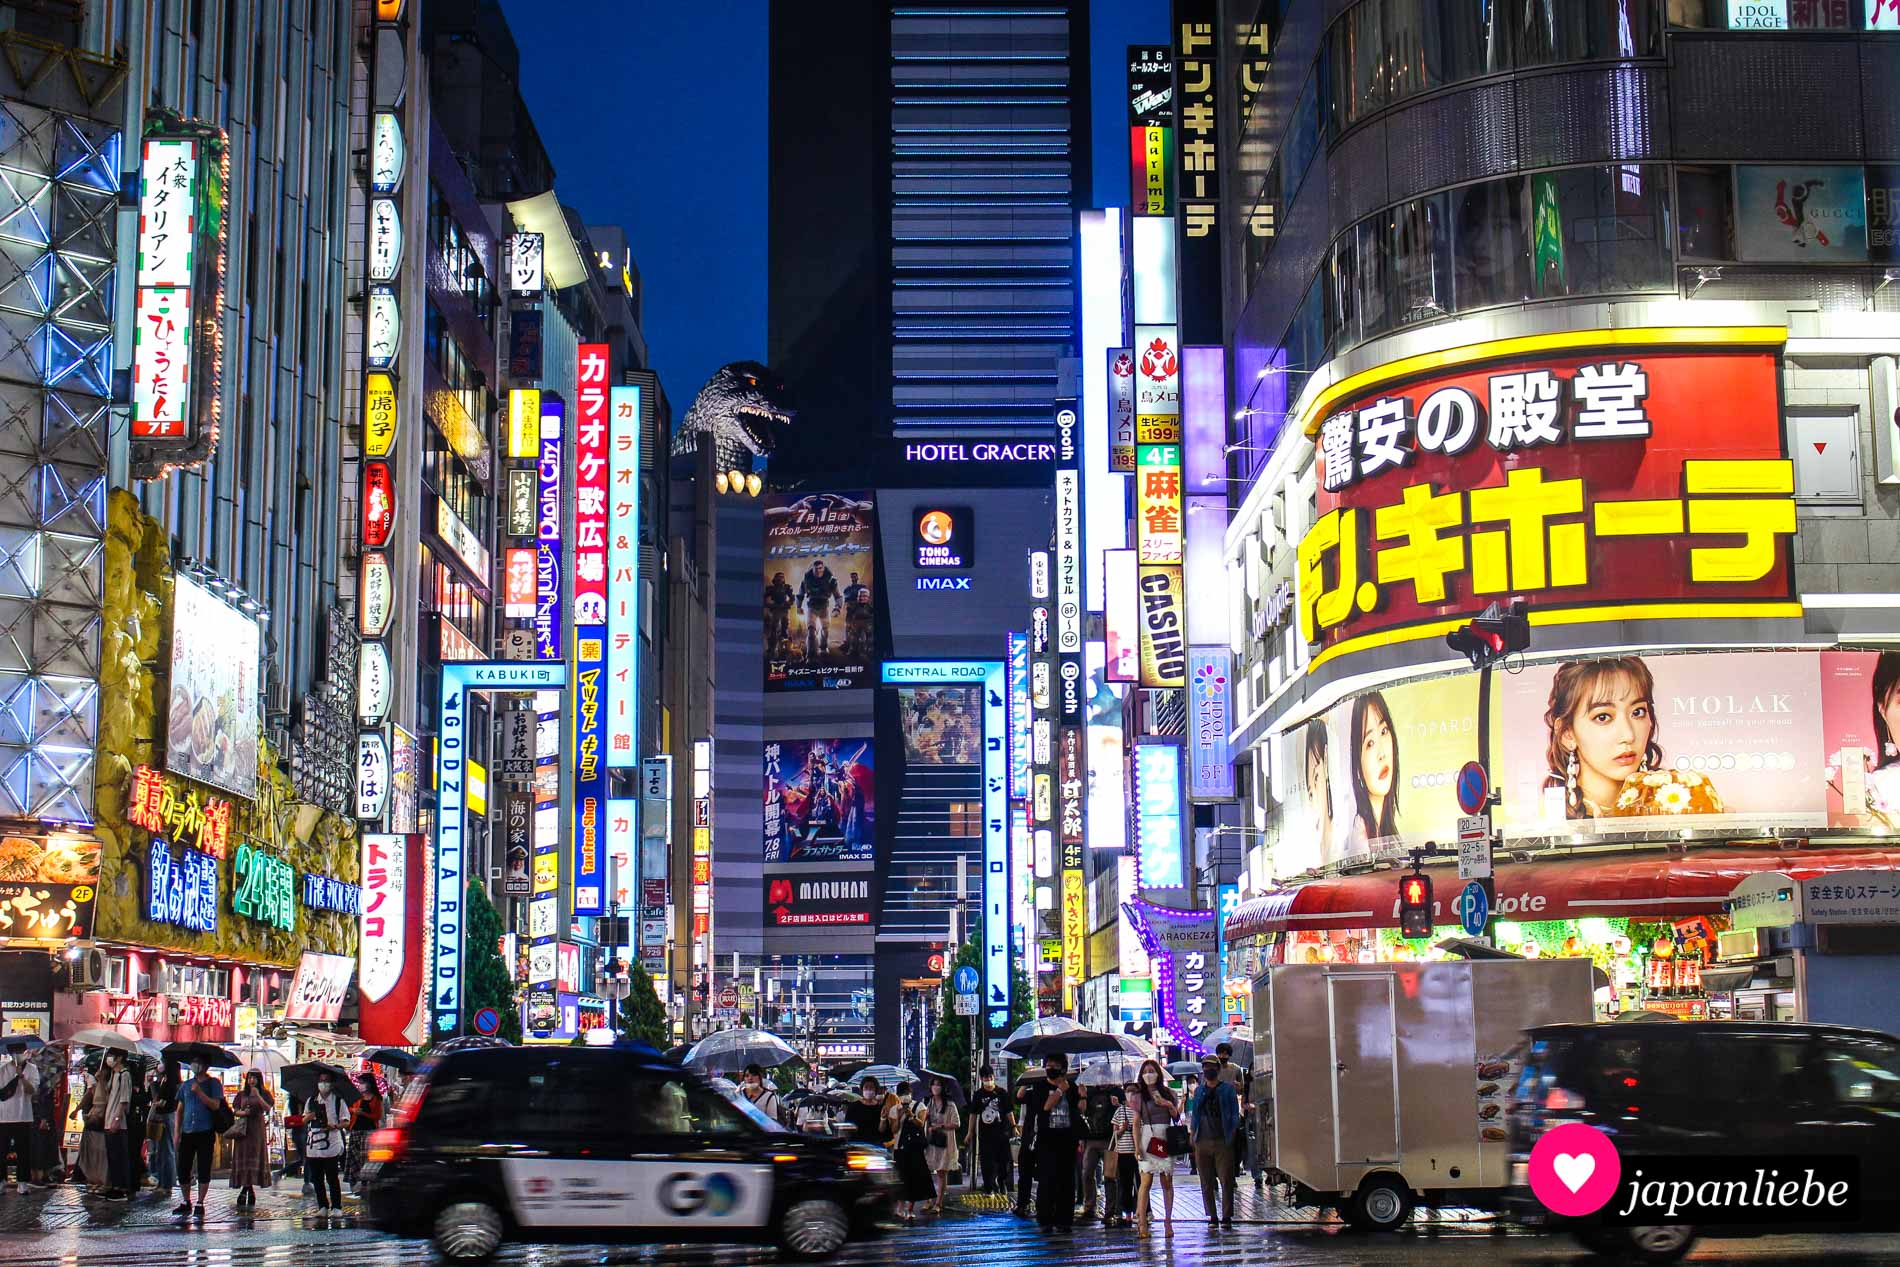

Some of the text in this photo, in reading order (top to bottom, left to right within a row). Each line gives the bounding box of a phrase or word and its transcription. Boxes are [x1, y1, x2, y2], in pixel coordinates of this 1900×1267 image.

[1735, 17, 1782, 28] STAGE
[1739, 5, 1778, 17] IDOL
[172, 156, 189, 189] 大衆
[1147, 131, 1163, 196] Garam
[377, 183, 390, 192] 7F
[150, 164, 173, 272] イタリアン
[1810, 208, 1863, 218] GUCCI
[372, 266, 392, 279] 6F
[517, 237, 536, 285] ダーツ
[147, 314, 175, 419] ひょうたん
[373, 357, 386, 366] 5F
[369, 396, 393, 437] 虎の子
[1141, 389, 1179, 404] 鳥メロ
[147, 421, 172, 435] 7F
[1057, 409, 1076, 461] Booth
[1117, 398, 1132, 442] 鳥メロ
[1141, 417, 1180, 428] 生ビール
[1321, 361, 1652, 493] 驚安の殿堂
[368, 444, 383, 453] 4F
[576, 353, 606, 582] カラオケ歌広場
[906, 444, 969, 461] HOTEL
[1145, 447, 1176, 464] 4F
[512, 472, 532, 527] 山内農場
[1062, 476, 1074, 536] ネットカフェ
[1144, 470, 1180, 534] 麻雀
[383, 512, 391, 531] 3F
[919, 546, 949, 557] TOHO
[919, 557, 961, 566] CINEMAS
[916, 577, 971, 590] IMAX
[1062, 554, 1074, 596] カプセル
[536, 554, 560, 646] SHINJUKU
[1140, 572, 1185, 681] CASINO
[581, 641, 600, 660] 薬
[1012, 639, 1027, 685] 747
[887, 666, 986, 677] CENTRAL ROAD
[1060, 661, 1080, 714] Booth
[579, 668, 601, 781] マツモトキヨシ
[1199, 700, 1224, 750] STAGE IDOL
[1671, 694, 1793, 715] MOLAK
[361, 803, 378, 813] B1
[764, 743, 781, 837] 神バトル開幕
[1061, 778, 1083, 837] 甘太郎
[510, 800, 527, 843] 海の家
[581, 798, 597, 875] Tax Free Shop
[438, 716, 461, 980] GODZILLA ROAD
[765, 851, 780, 862] FRI
[987, 736, 1005, 957] ゴジラロード
[1064, 845, 1081, 855] 4F
[1064, 856, 1081, 866] 3F
[75, 889, 90, 899] 2F
[150, 837, 218, 933] 飲み放題
[233, 842, 296, 932] 24時間
[365, 843, 388, 938] トラノコ
[799, 880, 868, 900] MARUHAN
[1184, 951, 1209, 1038] カラオケ
[1224, 996, 1247, 1013] B1
